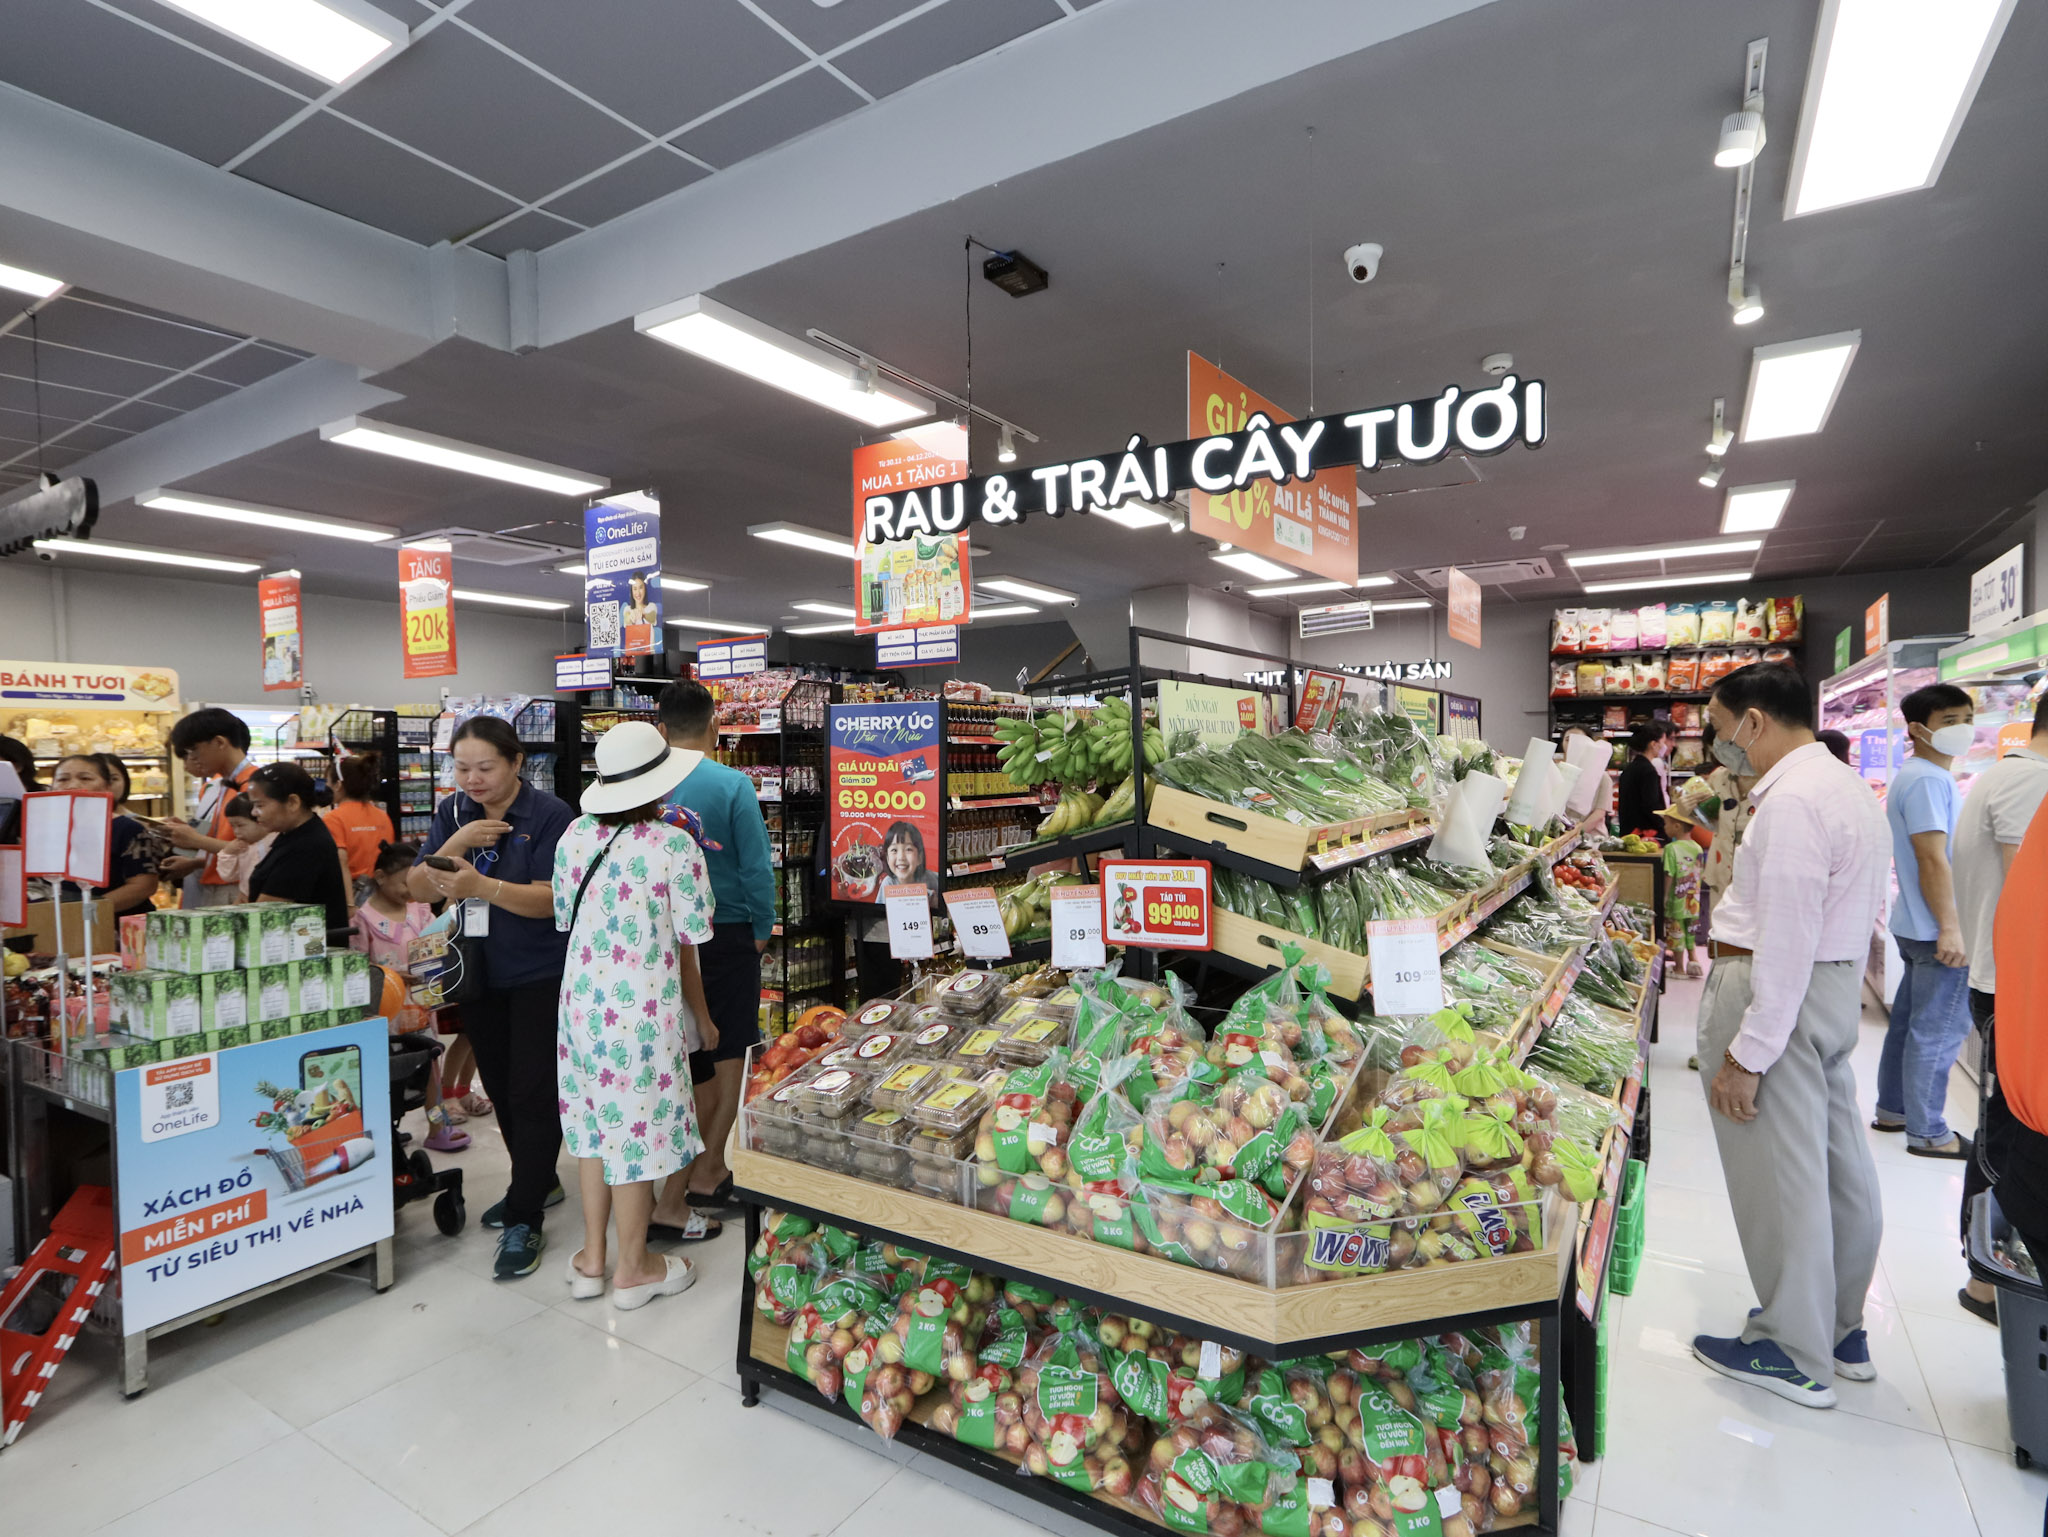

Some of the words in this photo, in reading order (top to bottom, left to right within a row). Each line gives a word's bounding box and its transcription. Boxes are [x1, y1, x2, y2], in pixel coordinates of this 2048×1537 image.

[865, 482, 964, 542] RAU
[981, 475, 1018, 523] &
[1031, 434, 1169, 515] TRÁI
[1191, 414, 1325, 490] CÂY
[1344, 375, 1542, 468] TƯƠI
[861, 474, 892, 492] MUA
[895, 471, 904, 486] 1
[906, 463, 946, 485] TẶNG
[950, 461, 958, 476] 1
[1274, 485, 1294, 514] An
[1296, 490, 1313, 522] Lá
[606, 520, 648, 540] OneLife?
[593, 559, 604, 571] TÚI
[605, 559, 619, 569] ECO
[619, 556, 636, 566] MUA
[637, 551, 652, 563] SẮM
[410, 612, 446, 643] 20k
[1407, 657, 1450, 680] SẢN
[1, 670, 66, 688] BÁNH
[72, 674, 125, 690] TƯƠI
[835, 714, 906, 732] CHERRY
[907, 711, 935, 730] ÚC
[2001, 736, 2027, 747] Xúc
[838, 759, 858, 772] GIÁ
[858, 761, 877, 772] ƯU
[877, 759, 899, 772] ĐÃI
[840, 775, 860, 785] Giảm
[838, 789, 926, 811] 69.000
[876, 811, 892, 819] 100g
[1171, 870, 1195, 882] 30.11
[1160, 891, 1173, 902] TÁO
[1174, 891, 1187, 903] TÚI
[1148, 902, 1199, 926] 99.000
[902, 921, 919, 931] 149
[972, 924, 989, 936] 89
[1069, 928, 1086, 941] 89
[1394, 970, 1422, 984] 109
[151, 1112, 209, 1134] OneLife
[1006, 1135, 1019, 1145] KG
[143, 1189, 211, 1218] XÁCH
[218, 1165, 253, 1195] ĐỒ
[1026, 1195, 1038, 1206] KG
[1346, 1194, 1394, 1219] APPLES
[144, 1217, 205, 1252] MIỄN
[212, 1199, 251, 1230] PHÍ
[1110, 1226, 1124, 1237] KG
[146, 1255, 182, 1283] TỪ
[187, 1239, 239, 1270] SIÊU
[245, 1224, 282, 1249] THỊ
[287, 1207, 315, 1234] VỀ
[320, 1195, 364, 1223] NHÀ
[923, 1322, 936, 1332] KG
[971, 1408, 985, 1417] KG
[1375, 1422, 1393, 1432] TƯƠI
[1388, 1428, 1408, 1438] VƯỜN
[1379, 1440, 1394, 1449] ĐẾN
[1395, 1437, 1410, 1447] NHÀ
[1282, 1499, 1297, 1510] KG
[1180, 1514, 1196, 1526] KG
[1407, 1518, 1415, 1531] 2
[1415, 1515, 1431, 1527] KG
